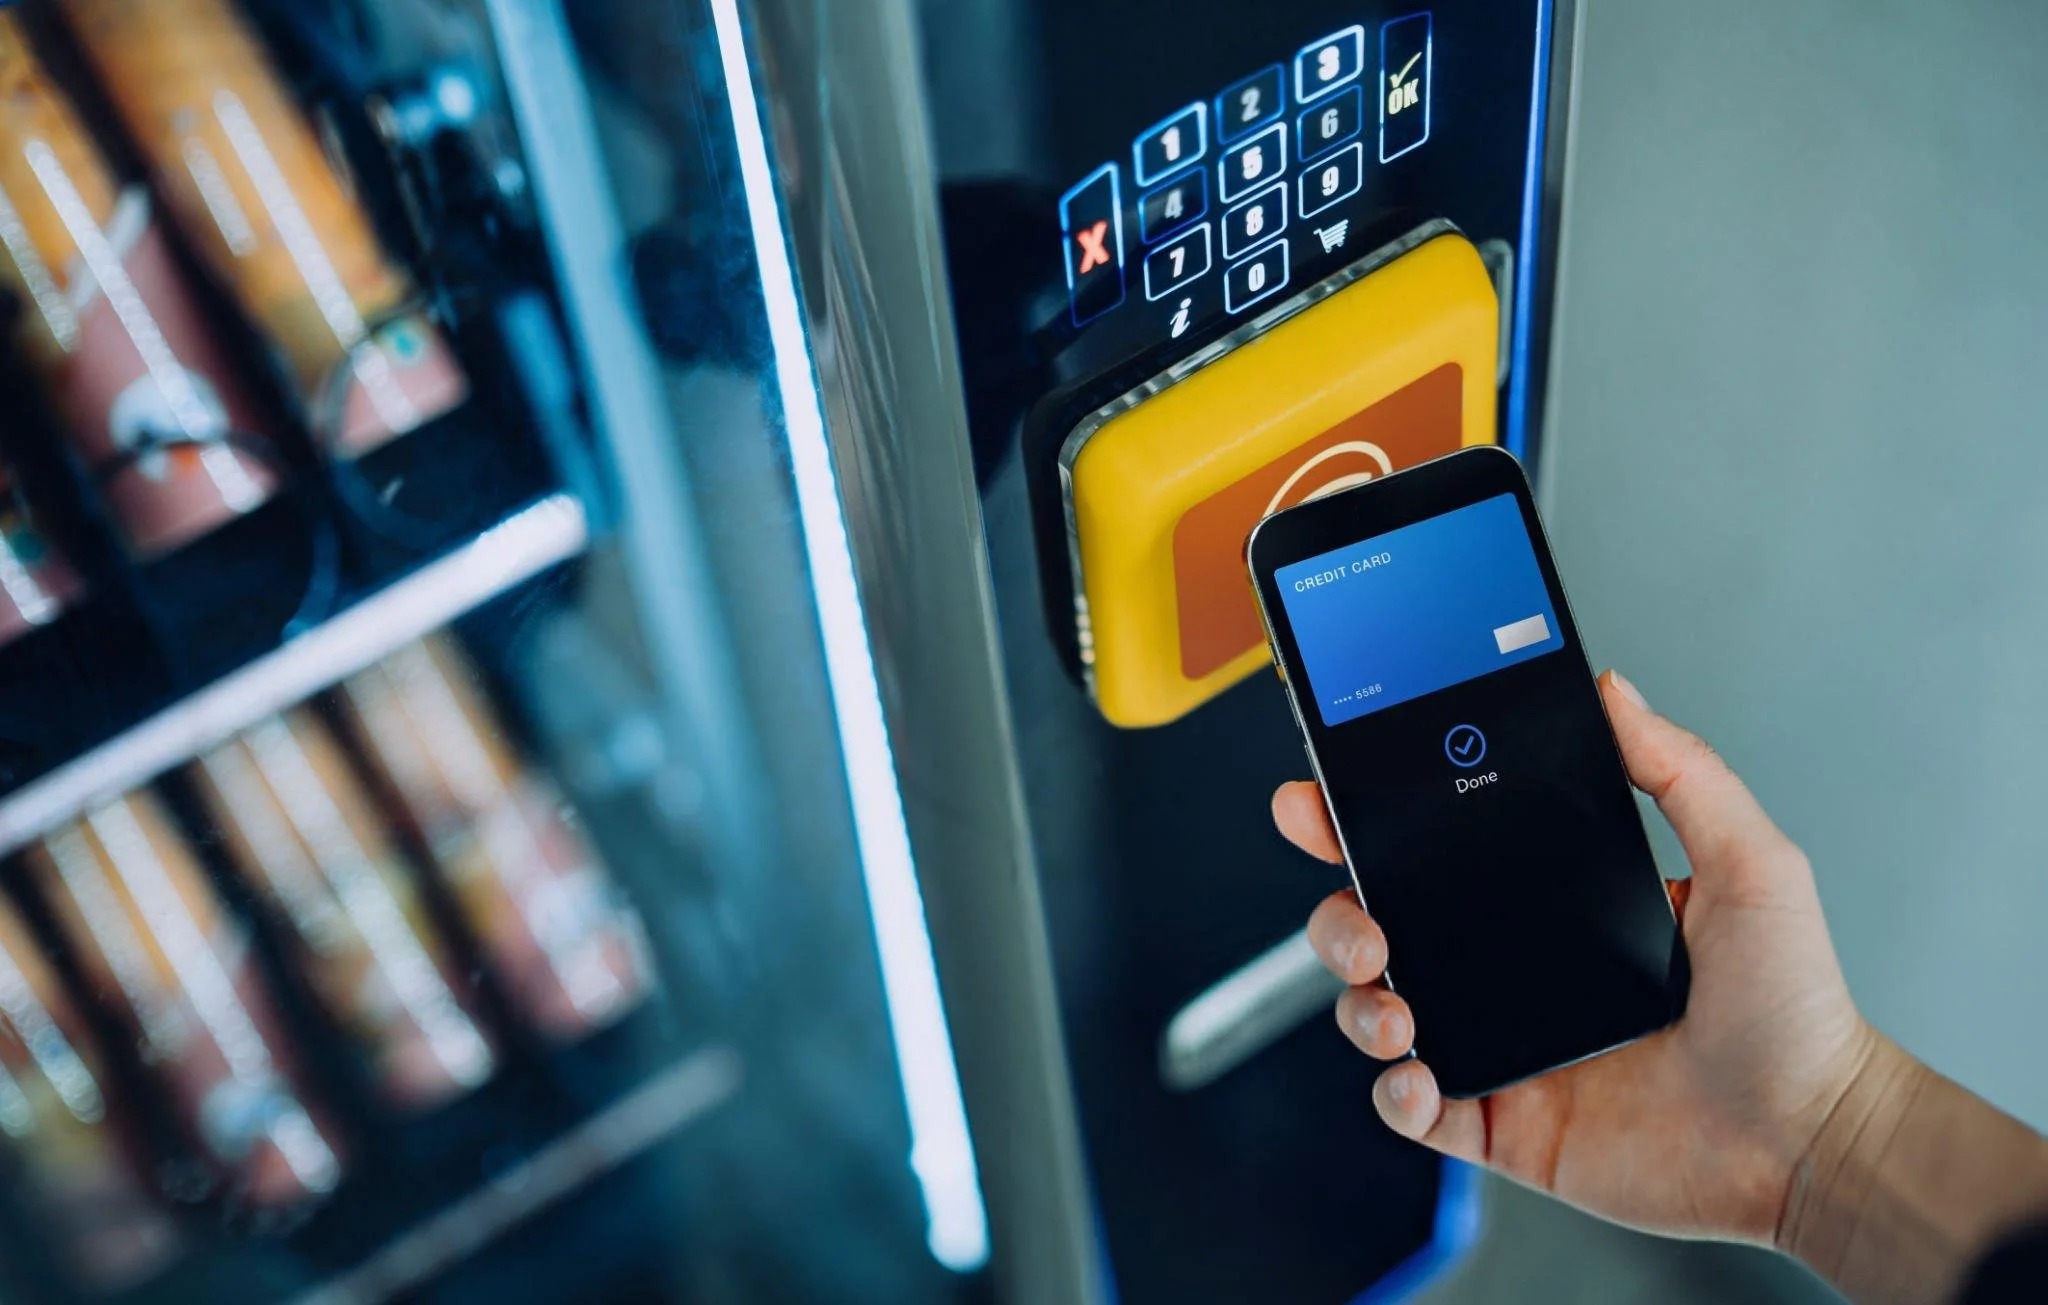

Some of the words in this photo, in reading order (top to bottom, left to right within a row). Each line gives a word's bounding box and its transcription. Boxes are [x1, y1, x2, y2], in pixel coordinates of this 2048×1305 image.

[1318, 45, 1341, 81] 3
[1241, 87, 1260, 122] 2
[1388, 78, 1419, 115] OK
[1321, 108, 1339, 139] 6
[1160, 127, 1181, 161] 1
[1242, 146, 1263, 180] 5
[1322, 165, 1339, 196] 9
[1164, 189, 1183, 219] 4
[1246, 205, 1264, 236] 8
[1169, 247, 1185, 278] 7
[1248, 262, 1265, 292] 0
[1295, 567, 1345, 592] CREDIT
[1352, 553, 1390, 573] CARD
[1356, 684, 1381, 699] 5586
[1456, 772, 1497, 793] Done
